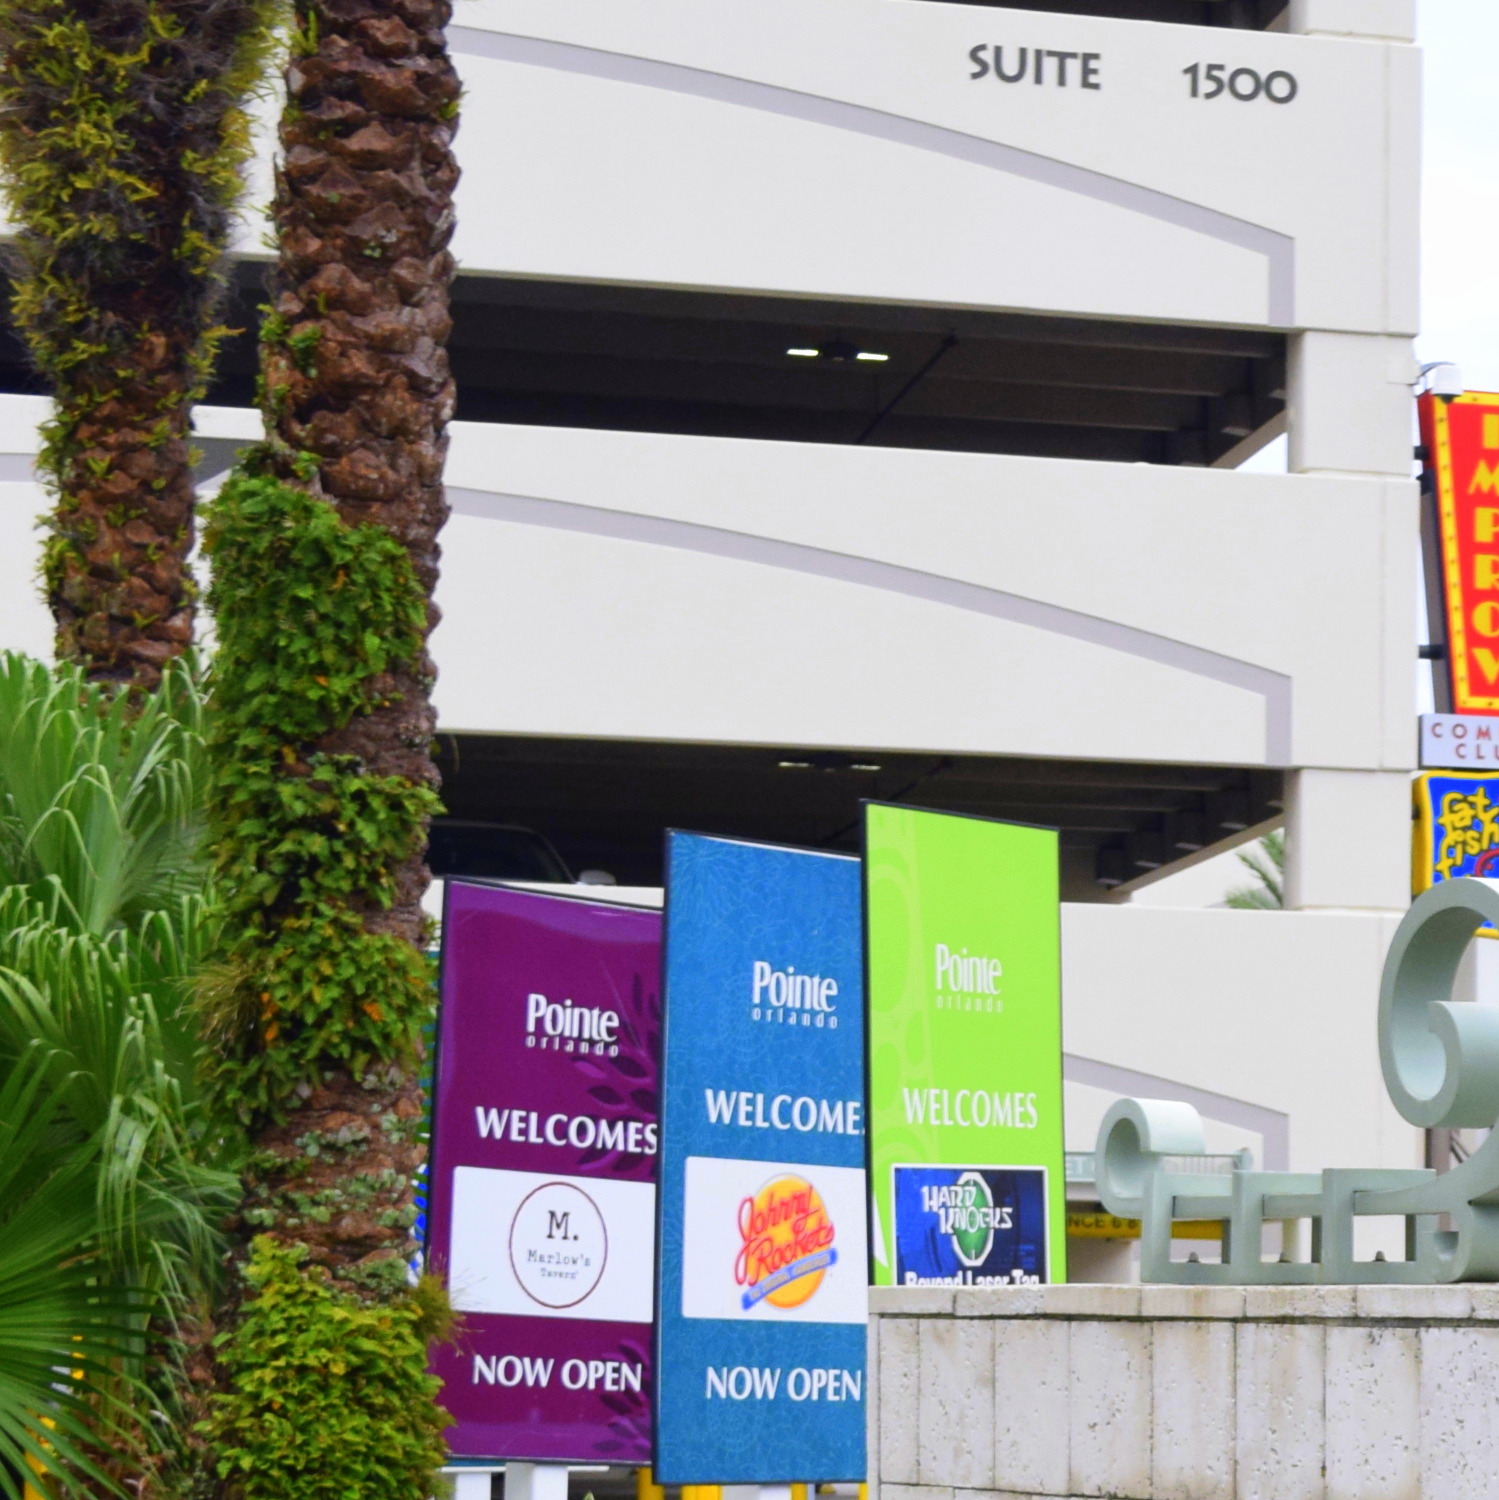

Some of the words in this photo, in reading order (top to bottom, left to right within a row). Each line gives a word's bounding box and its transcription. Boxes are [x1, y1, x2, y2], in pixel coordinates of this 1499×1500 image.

[968, 43, 1102, 91] SUITE
[1182, 61, 1298, 104] 1500
[752, 960, 838, 1012] Pointe
[935, 943, 1003, 995] Pointe
[525, 993, 620, 1042] Pointe
[752, 1007, 838, 1029] orlando
[936, 994, 1004, 1013] orlando
[525, 1035, 619, 1057] orlando
[704, 1088, 866, 1136] WELCOME
[902, 1087, 1038, 1129] WELCOMES
[474, 1105, 658, 1155] WELCOMES
[920, 1185, 977, 1212] HARD
[546, 1210, 579, 1241] M.
[735, 1184, 821, 1285] Johnny
[938, 1206, 1014, 1235] KNOCKS
[527, 1249, 591, 1267] Marlow's
[744, 1215, 835, 1287] Rockets
[472, 1354, 554, 1388] NOW
[561, 1358, 642, 1393] OPEN
[705, 1365, 781, 1400] NOW
[787, 1367, 862, 1402] OPEN
